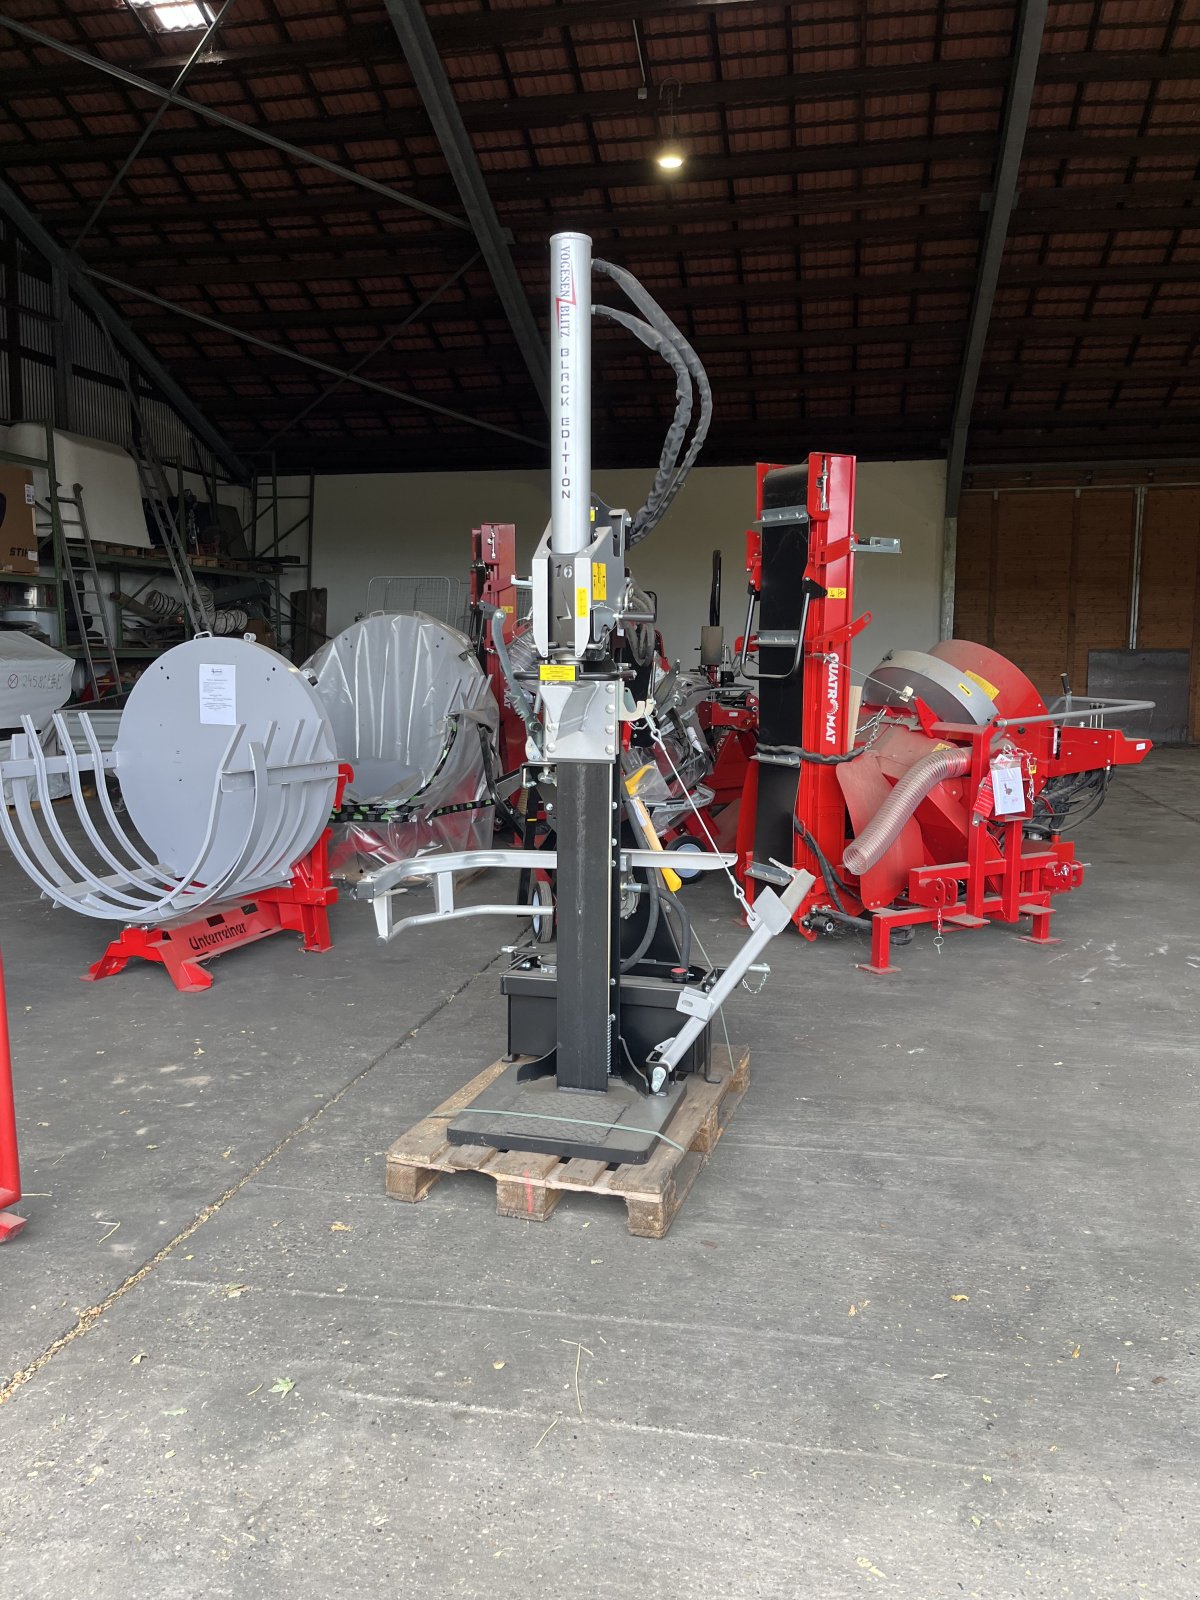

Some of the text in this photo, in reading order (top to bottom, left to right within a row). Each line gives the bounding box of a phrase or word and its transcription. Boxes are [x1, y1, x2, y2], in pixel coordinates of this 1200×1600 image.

[560, 245, 571, 338] VOGESEN BLITZ
[560, 347, 571, 499] BLACK EDITION
[9, 547, 34, 557] STIH
[555, 560, 573, 579] 16
[188, 922, 247, 951] Unterreiner
